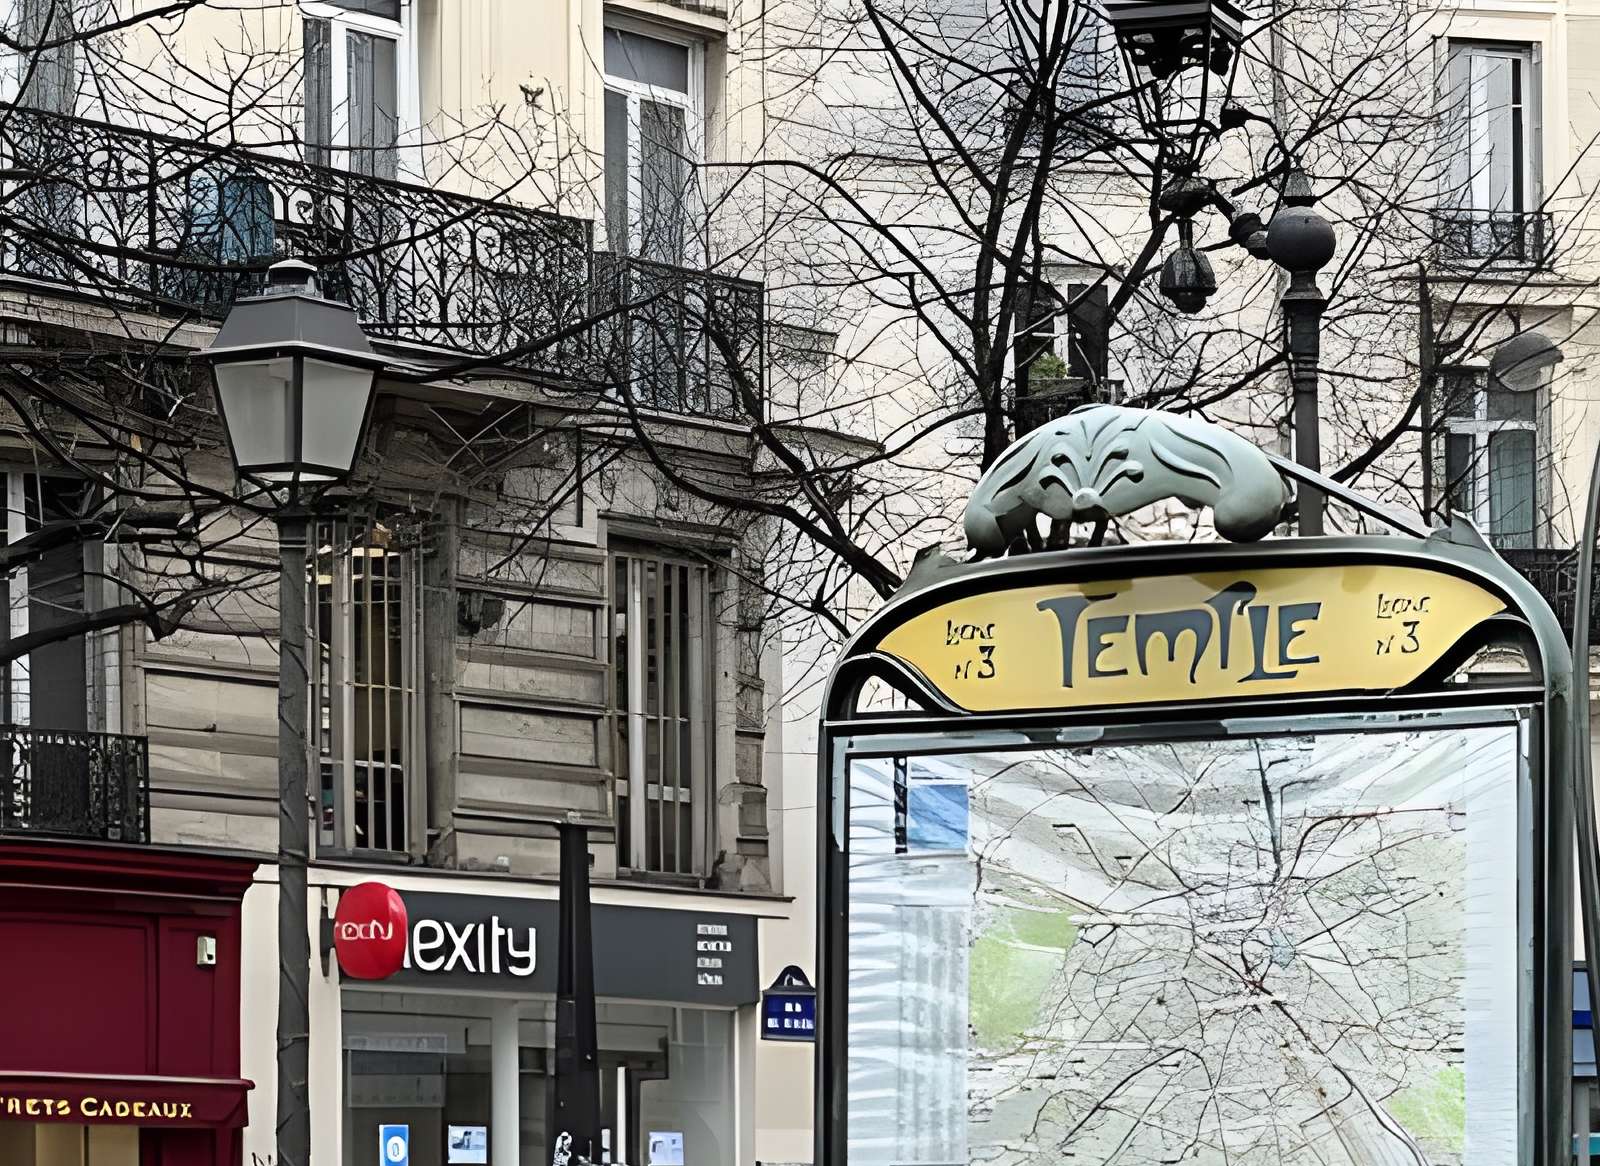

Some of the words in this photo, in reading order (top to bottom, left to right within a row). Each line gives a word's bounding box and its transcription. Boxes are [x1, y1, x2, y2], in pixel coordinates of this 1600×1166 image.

[1036, 580, 1322, 689] TEMPLE
[403, 915, 537, 977] exity
[79, 1096, 194, 1119] CADEAUX
